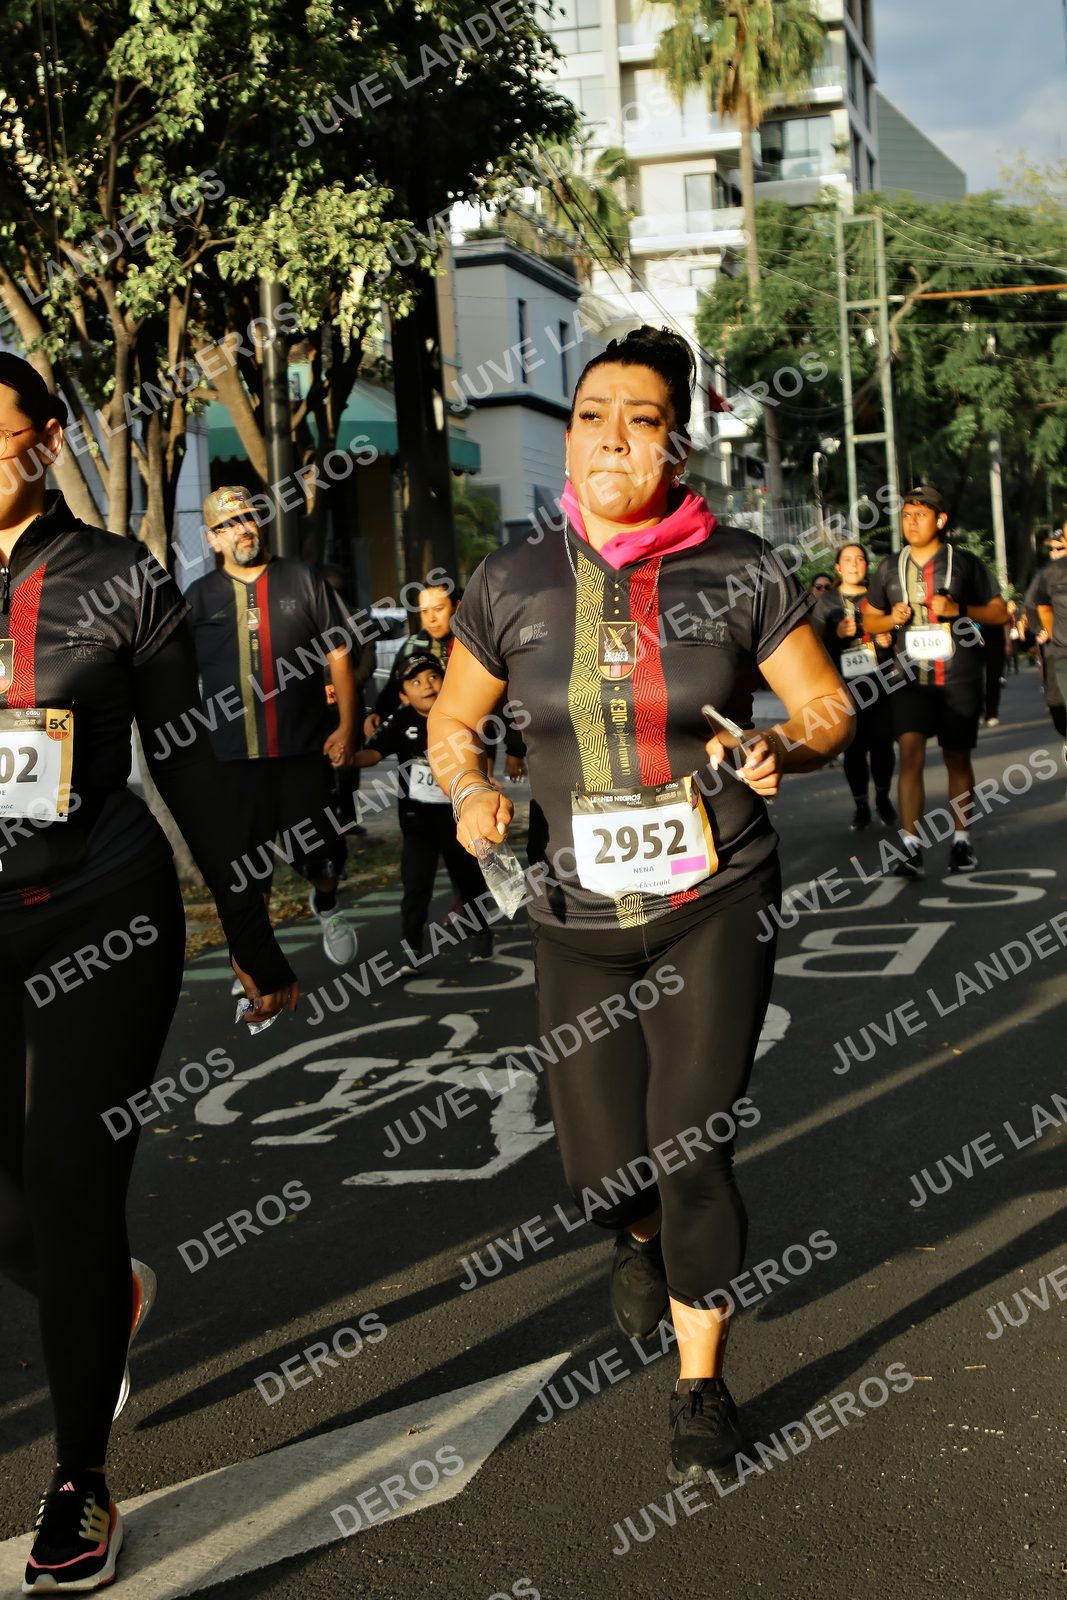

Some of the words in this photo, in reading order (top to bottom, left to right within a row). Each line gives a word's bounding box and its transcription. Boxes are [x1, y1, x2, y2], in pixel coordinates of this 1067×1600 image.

[845, 653, 870, 668] 3421
[49, 718, 67, 731] 5K
[592, 819, 688, 865] 2952
[633, 866, 655, 874] NENA
